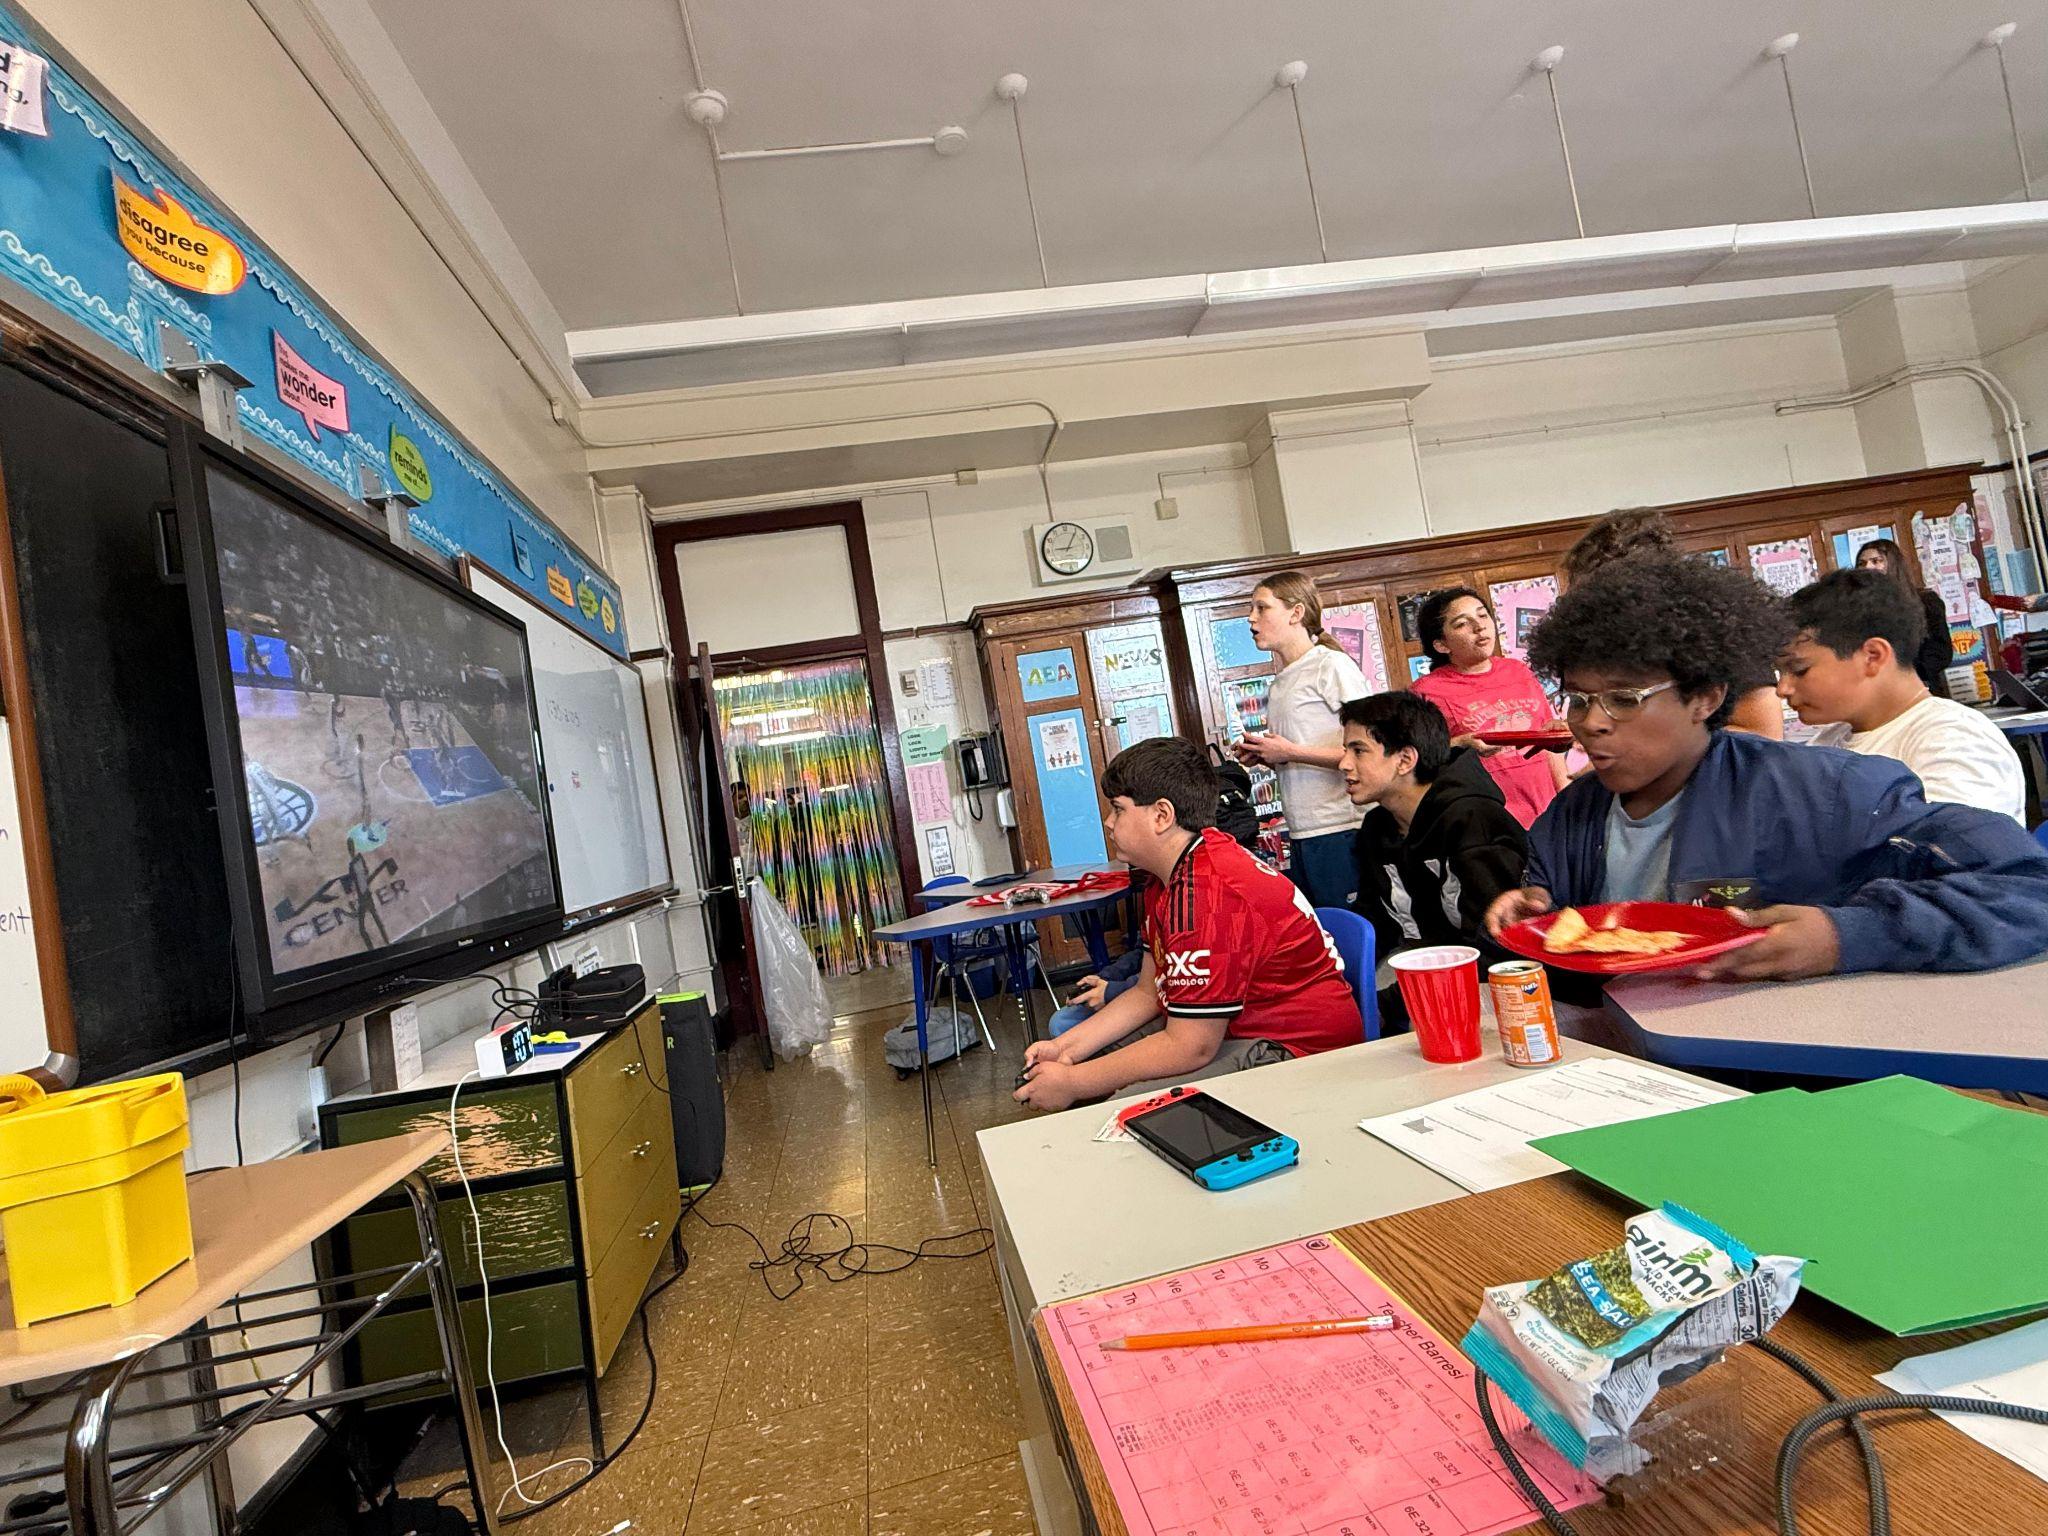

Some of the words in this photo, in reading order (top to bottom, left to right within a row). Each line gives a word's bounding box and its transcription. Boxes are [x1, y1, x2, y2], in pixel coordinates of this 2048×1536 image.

[119, 198, 209, 257] disagree
[144, 238, 206, 273] because
[281, 369, 337, 409] wonder
[394, 451, 429, 485] reminds
[1952, 640, 1971, 655] YET
[1104, 648, 1162, 673] NEWS
[1027, 661, 1073, 687] AEA
[1238, 683, 1265, 697] YOU
[1249, 771, 1277, 784] Mak
[284, 879, 409, 947] CENER
[667, 1036, 675, 1049] R
[1252, 1256, 1270, 1271] Mo
[1211, 1268, 1226, 1281] Tu
[1166, 1278, 1182, 1295] We
[1643, 1274, 1674, 1303] NACKS
[1122, 1291, 1138, 1306] Th
[1737, 1282, 1747, 1318] Calories
[1377, 1301, 1423, 1342] Techer
[1418, 1339, 1469, 1381] Barresi
[1740, 1324, 1755, 1340] 30
[1432, 1450, 1462, 1477] 6E.321
[1427, 1494, 1441, 1510] MATH
[1365, 1515, 1378, 1531] MATH
